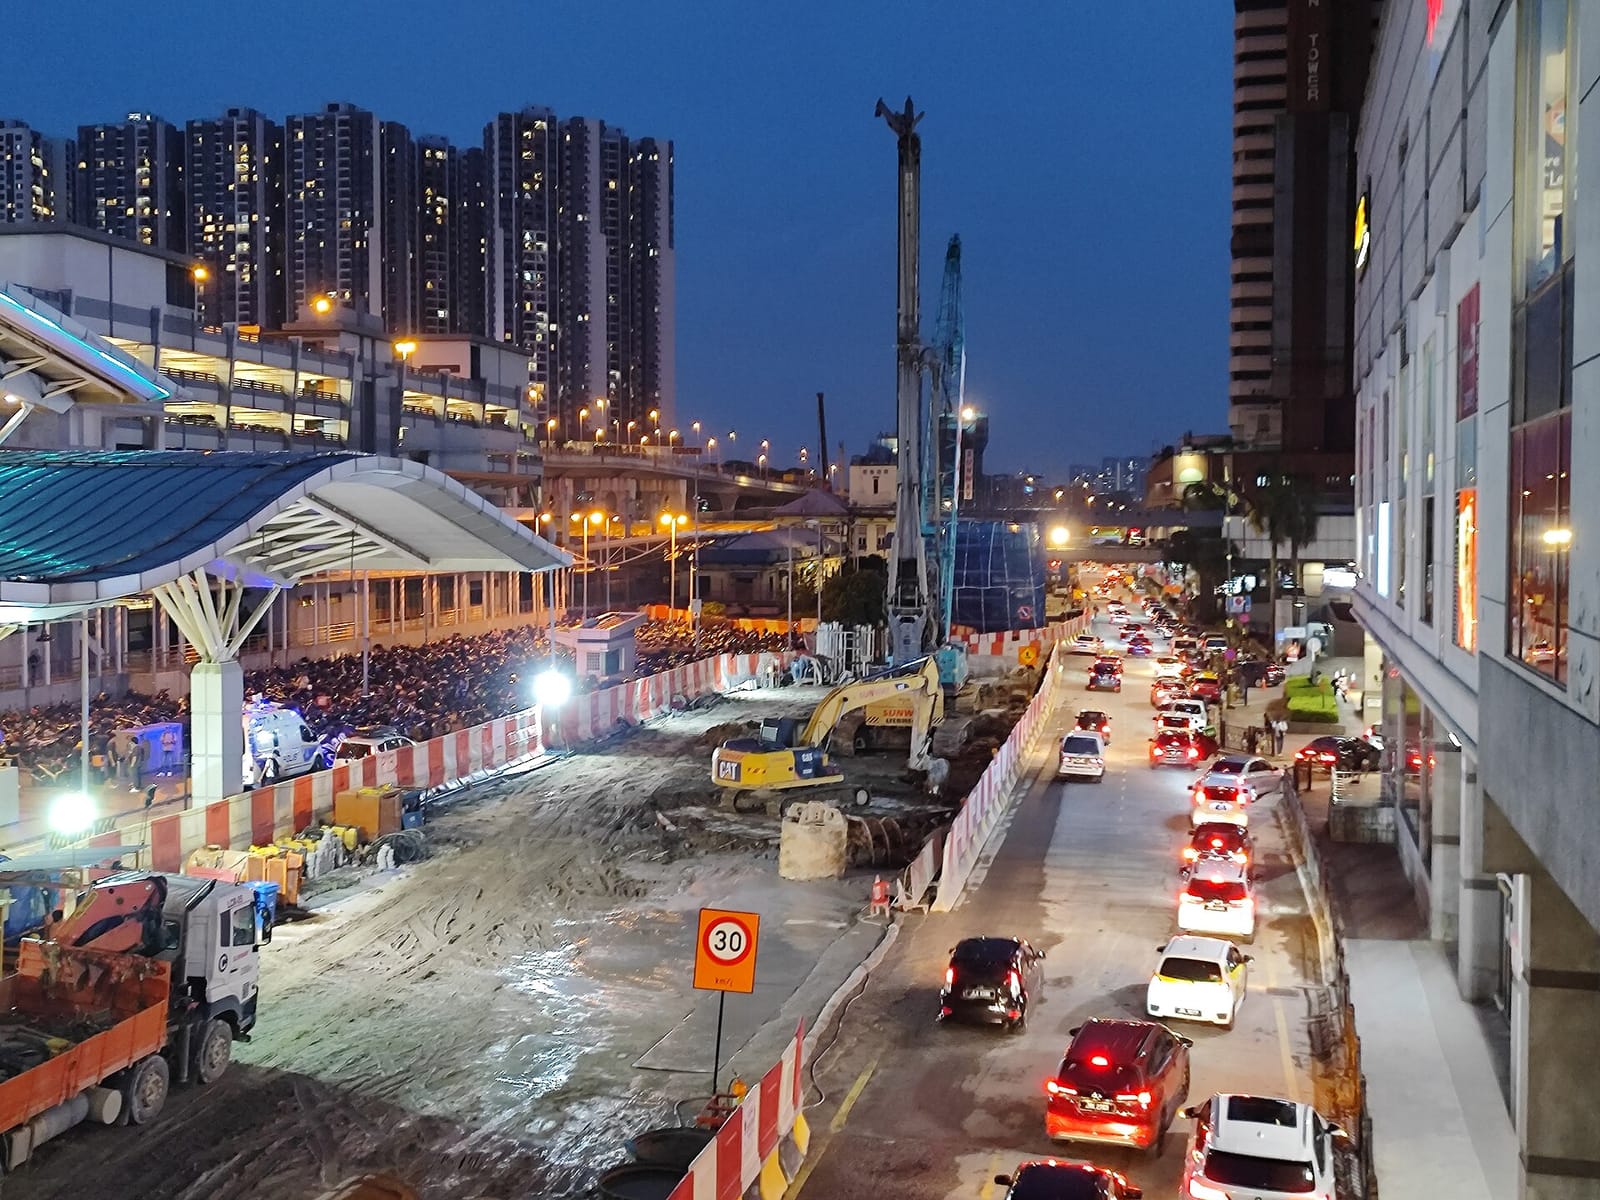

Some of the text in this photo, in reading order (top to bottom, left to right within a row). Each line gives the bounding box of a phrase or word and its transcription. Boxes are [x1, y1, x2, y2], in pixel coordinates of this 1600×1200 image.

[1307, 33, 1319, 101] TOWER
[719, 760, 738, 781] CAT
[714, 929, 742, 953] 30
